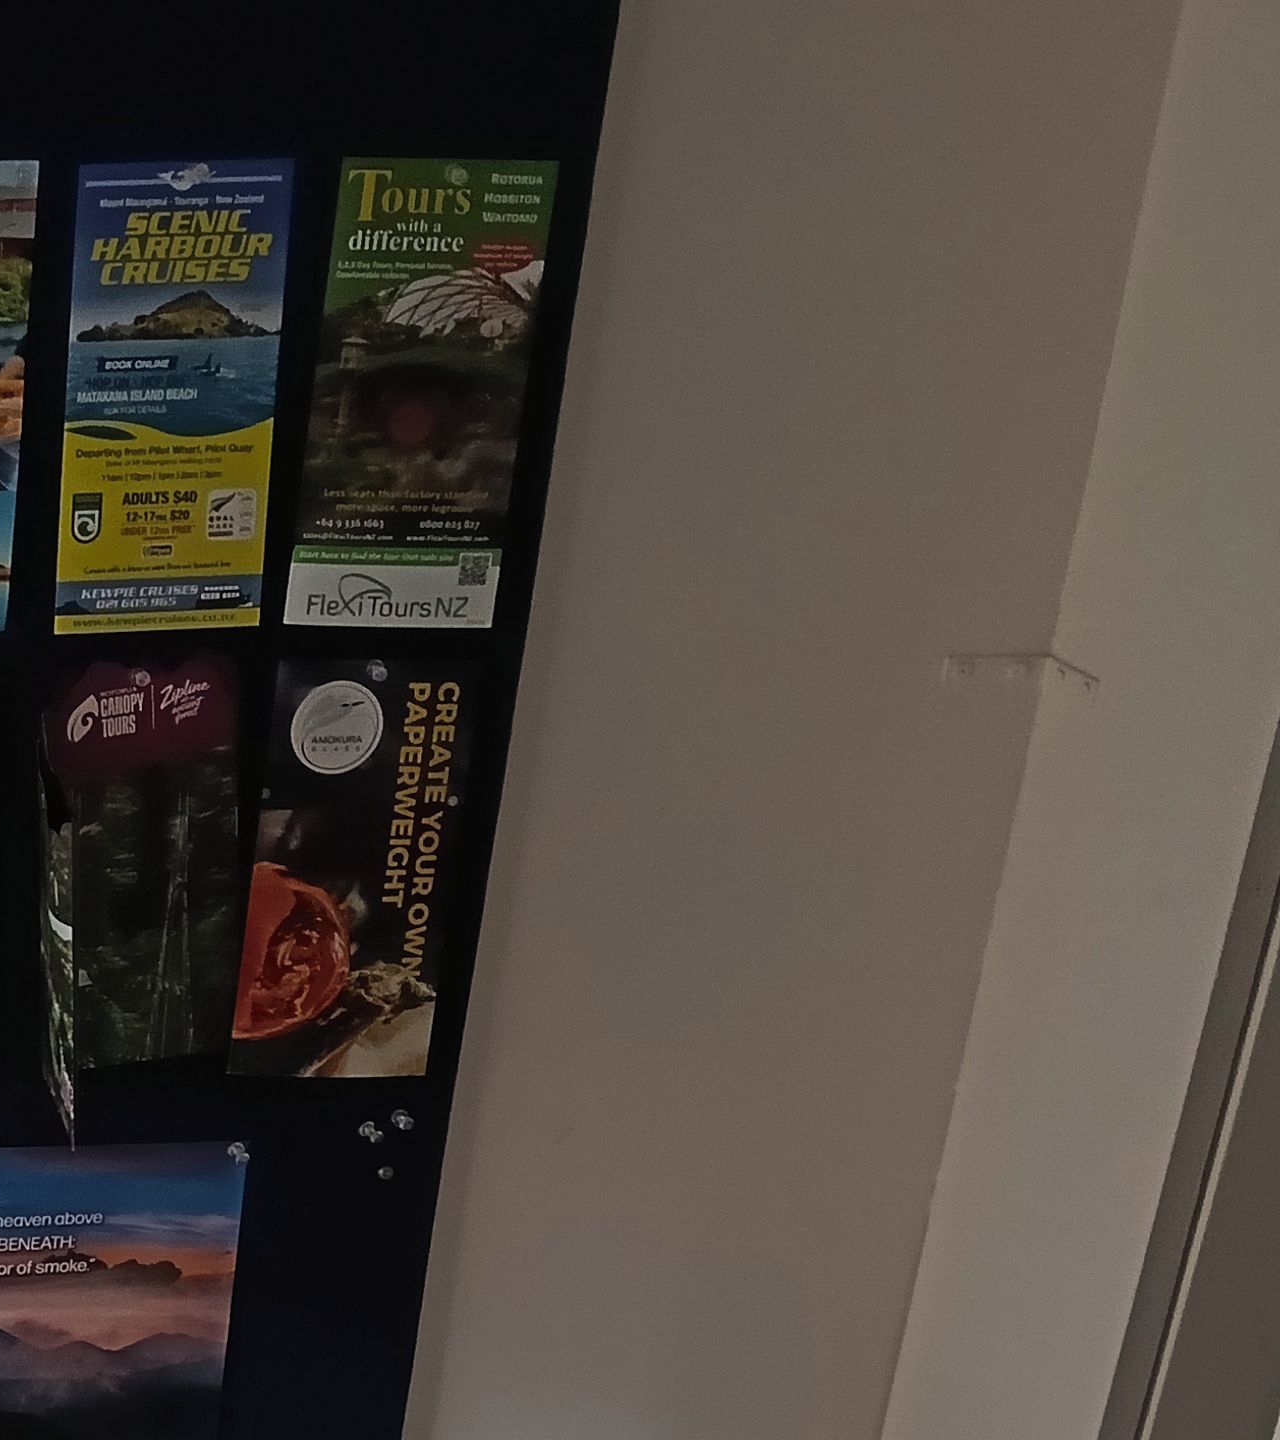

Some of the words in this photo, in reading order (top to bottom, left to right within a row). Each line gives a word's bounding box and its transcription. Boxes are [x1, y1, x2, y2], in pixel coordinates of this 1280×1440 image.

[348, 169, 472, 222] Tours
[126, 209, 251, 234] SCENIC
[91, 233, 272, 262] HARBOUR
[348, 228, 464, 253] difference
[99, 259, 251, 285] CRUISES
[122, 491, 170, 506] ADULTS
[172, 490, 198, 504] $40
[100, 691, 144, 718] CANOPY
[101, 714, 136, 738] TOURS
[424, 681, 460, 803] CREATE
[381, 682, 431, 908] PAPERWEIGHT
[407, 811, 444, 895] YOUR
[397, 901, 429, 979] OWN
[55, 1211, 103, 1226] above
[16, 1260, 32, 1275] of
